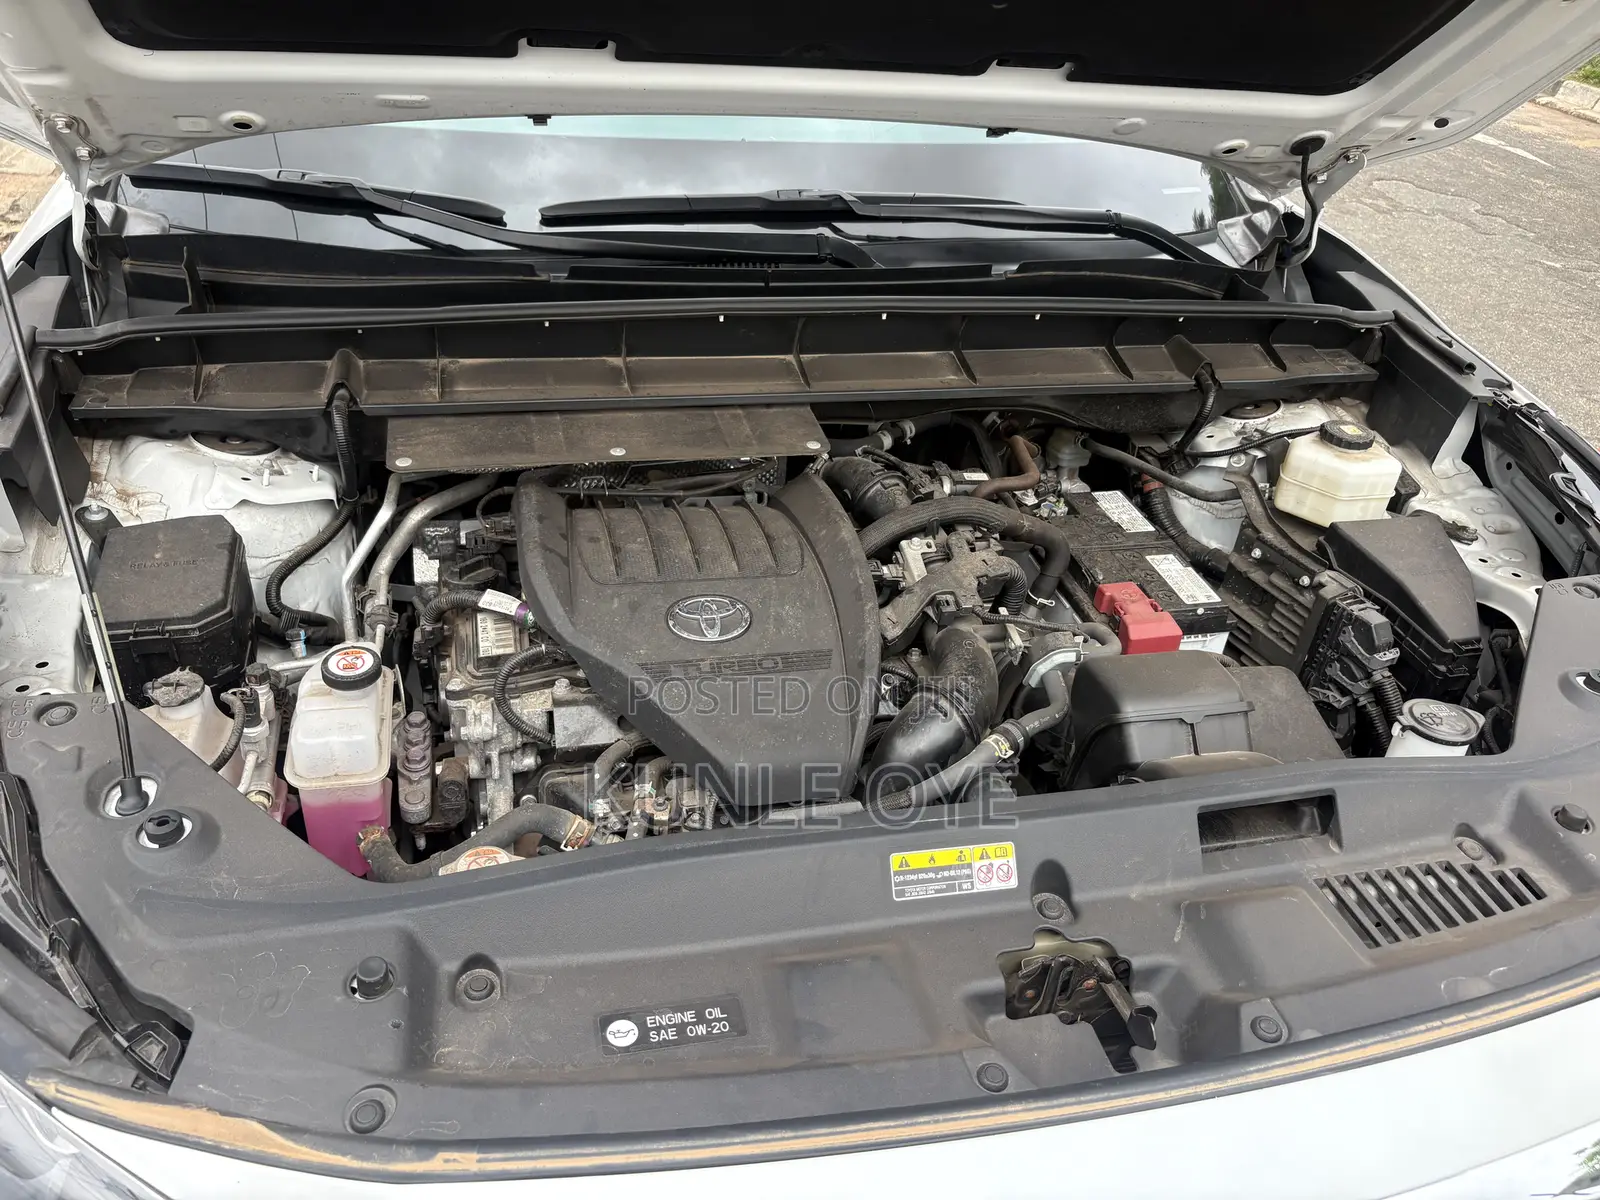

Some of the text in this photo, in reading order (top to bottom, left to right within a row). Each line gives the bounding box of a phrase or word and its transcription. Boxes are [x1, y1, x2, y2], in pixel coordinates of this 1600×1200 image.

[646, 1007, 728, 1028] ENGINE OIL
[649, 1021, 730, 1042] SAE 0W-20
